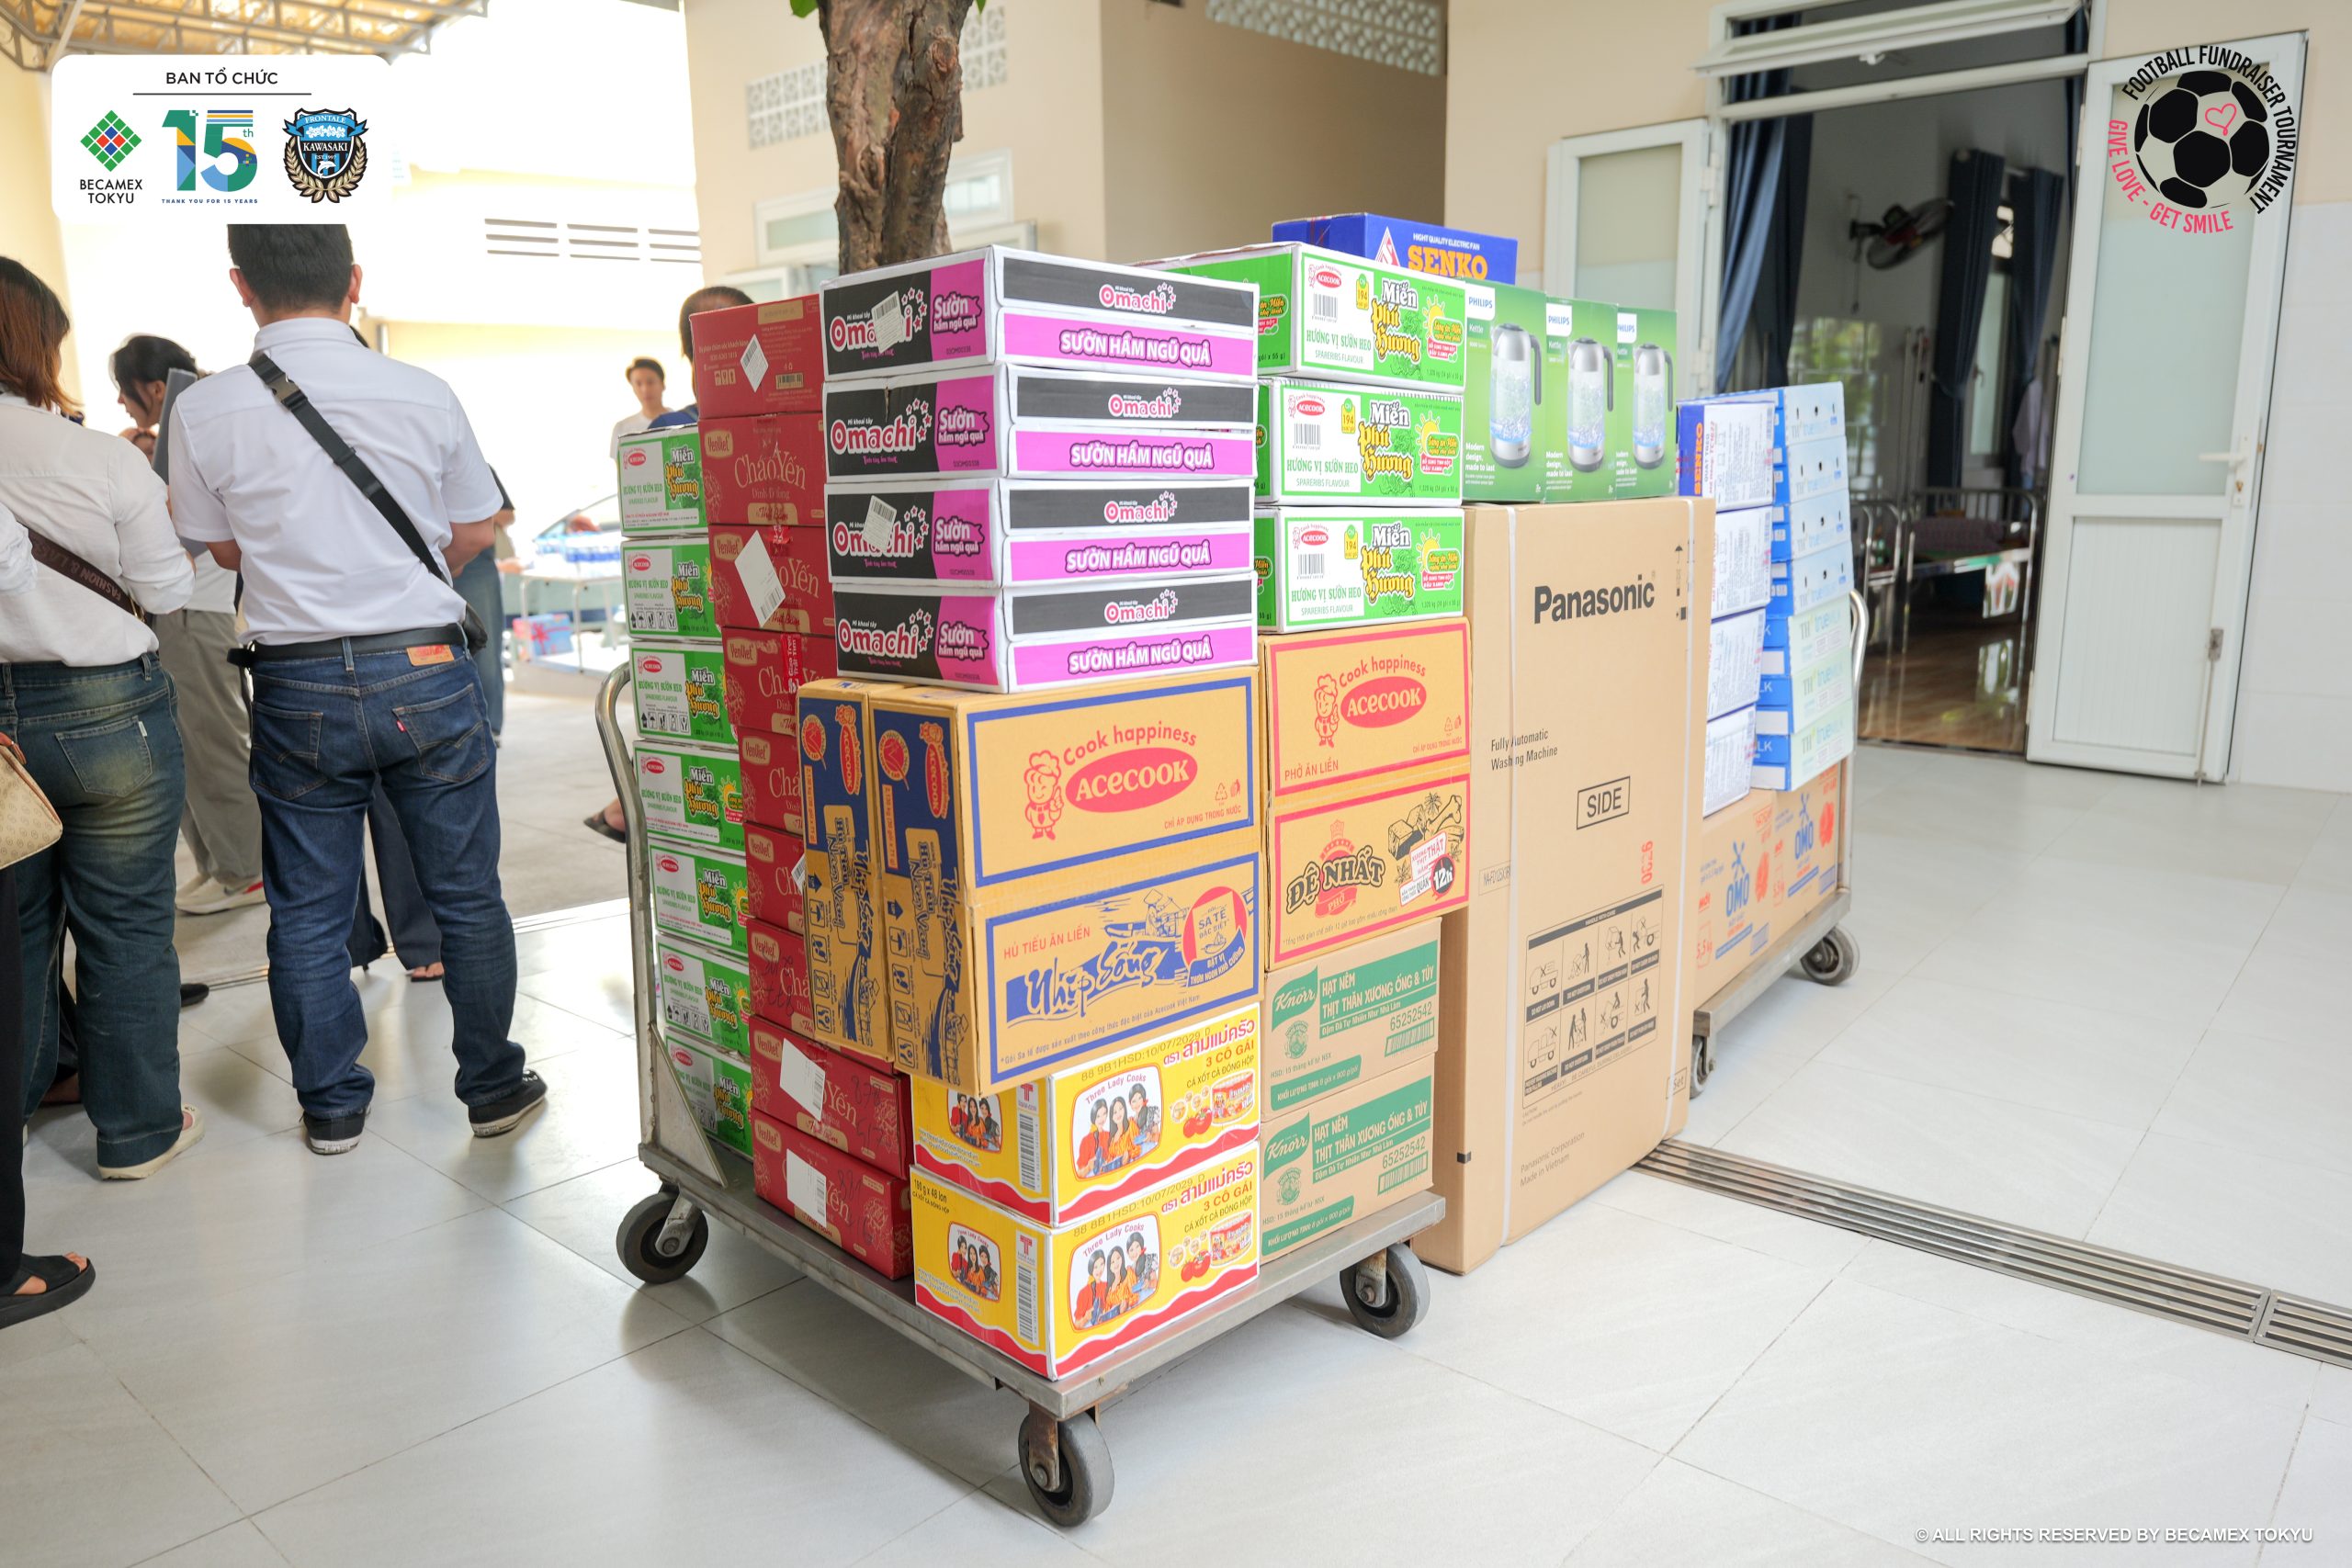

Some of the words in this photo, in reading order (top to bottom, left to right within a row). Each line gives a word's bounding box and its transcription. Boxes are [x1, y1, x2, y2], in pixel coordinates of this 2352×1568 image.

[1408, 245, 1487, 280] SENKO
[1100, 284, 1167, 313] Omachi
[1382, 278, 1418, 309] Miến
[1469, 297, 1493, 309] PHILIPS
[1548, 316, 1569, 325] PHILIPS
[1060, 329, 1107, 356] SƯỜN
[1109, 331, 1146, 359] HẦM
[1147, 337, 1178, 364] NGŨ
[1180, 340, 1212, 367] QUẢ
[940, 408, 975, 431] Sườn
[1108, 394, 1172, 418] Omachi
[1371, 401, 1409, 427] Miến
[831, 414, 916, 454] Omachi
[1070, 441, 1115, 467] SƯỜN
[1116, 440, 1151, 467] HẦM
[1152, 443, 1183, 468] NGŨ
[1183, 443, 1215, 470] QUẢ
[1104, 500, 1168, 524] Omachi
[1373, 523, 1410, 547] Miến
[1066, 547, 1112, 572] SƯỜN
[1112, 543, 1148, 570] HẦM
[1148, 541, 1181, 568] NGŨ
[1181, 539, 1211, 568] QUẢ
[1292, 587, 1317, 603] HƯƠNG
[1349, 587, 1361, 598] HEO
[1301, 605, 1329, 615] SPARERIBS
[1330, 604, 1353, 613] FLAVOUR
[1534, 574, 1655, 625] Panasonic
[1104, 598, 1169, 624] Omachi
[838, 618, 919, 658] Omachi
[1069, 647, 1114, 673] SƯỜN
[1114, 642, 1148, 669] HẦM
[1149, 638, 1182, 666] NGŨ
[1182, 635, 1213, 663] QUẢ
[1340, 660, 1368, 688] Cook
[1372, 655, 1426, 676] happiness
[1064, 730, 1108, 765] Cook
[1114, 721, 1196, 746] happiness
[1491, 737, 1509, 751] Fully
[1491, 755, 1524, 771] Washng
[1526, 746, 1557, 762] Machine
[690, 767, 713, 784] Miến
[1205, 810, 1224, 822] TRONG
[1587, 787, 1622, 818] SIDE
[1794, 821, 1814, 860] OMO
[1287, 863, 1319, 913] ĐỆ
[1323, 845, 1385, 892] NHẤT
[1726, 873, 1749, 917] OMO
[1199, 917, 1212, 930] SA
[1274, 988, 1316, 1011] Knorr
[1323, 980, 1336, 999] HẠT
[1323, 1002, 1339, 1019] THỊT
[1414, 972, 1419, 984] &
[1390, 1001, 1432, 1032] 65252542
[1206, 1057, 1212, 1067] 3
[1216, 1050, 1232, 1063] CÔ
[1236, 1041, 1254, 1055] GÁI
[1086, 1086, 1105, 1104] Three
[1108, 1077, 1124, 1089] Lady
[1126, 1074, 1147, 1083] Cooks
[1267, 1135, 1307, 1161] Knorr
[1382, 1136, 1425, 1169] 65252542
[1521, 1152, 1549, 1172] Panasonic
[1551, 1132, 1585, 1156] Corporation
[1520, 1173, 1537, 1187] Made
[1545, 1154, 1570, 1171] Vietnam
[1204, 1201, 1210, 1212] 3
[1214, 1190, 1230, 1206] CÔ
[1234, 1181, 1252, 1197] GÁI
[1083, 1238, 1102, 1257] Three
[1105, 1228, 1122, 1240] Lady
[1125, 1224, 1144, 1233] Cooks
